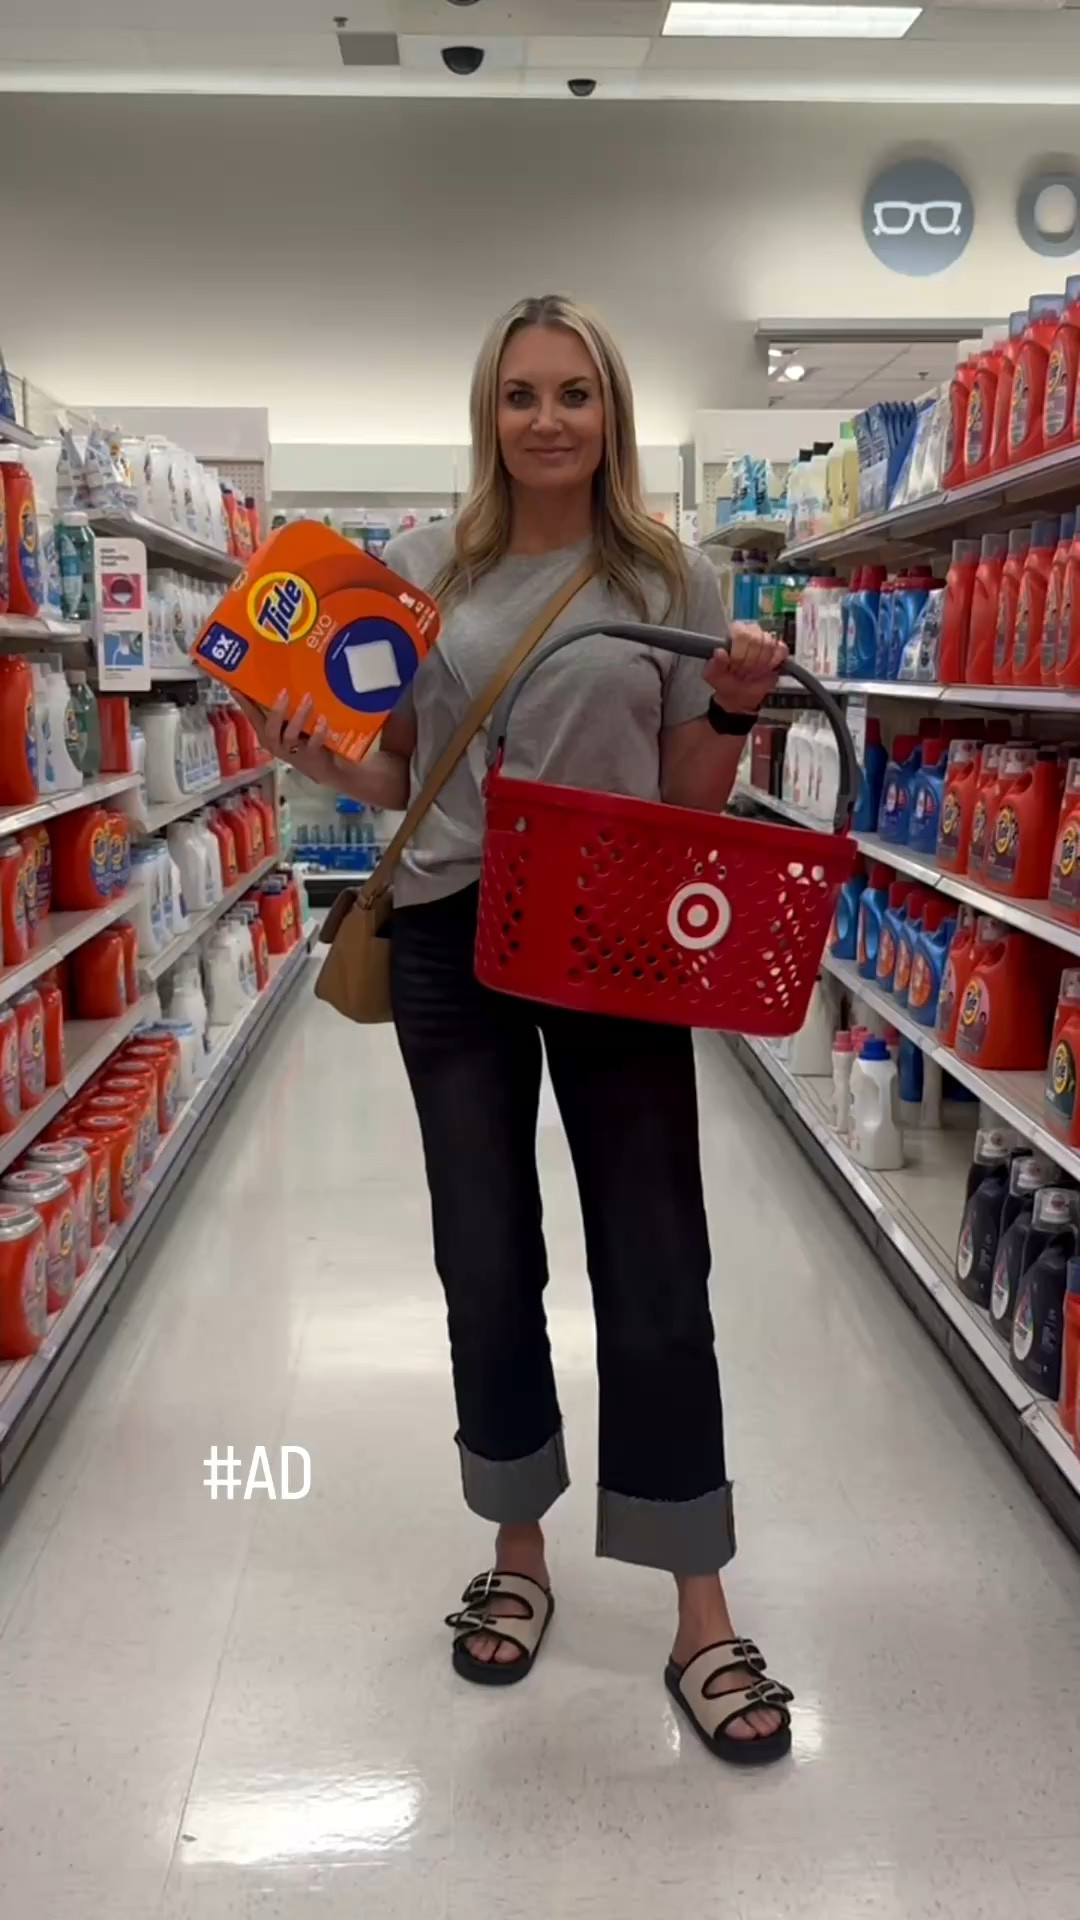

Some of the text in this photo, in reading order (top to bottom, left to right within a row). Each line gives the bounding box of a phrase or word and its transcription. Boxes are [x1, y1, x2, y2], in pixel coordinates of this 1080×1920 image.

[257, 578, 303, 645] Tide
[211, 632, 235, 660] 6X
[306, 614, 332, 649] evo
